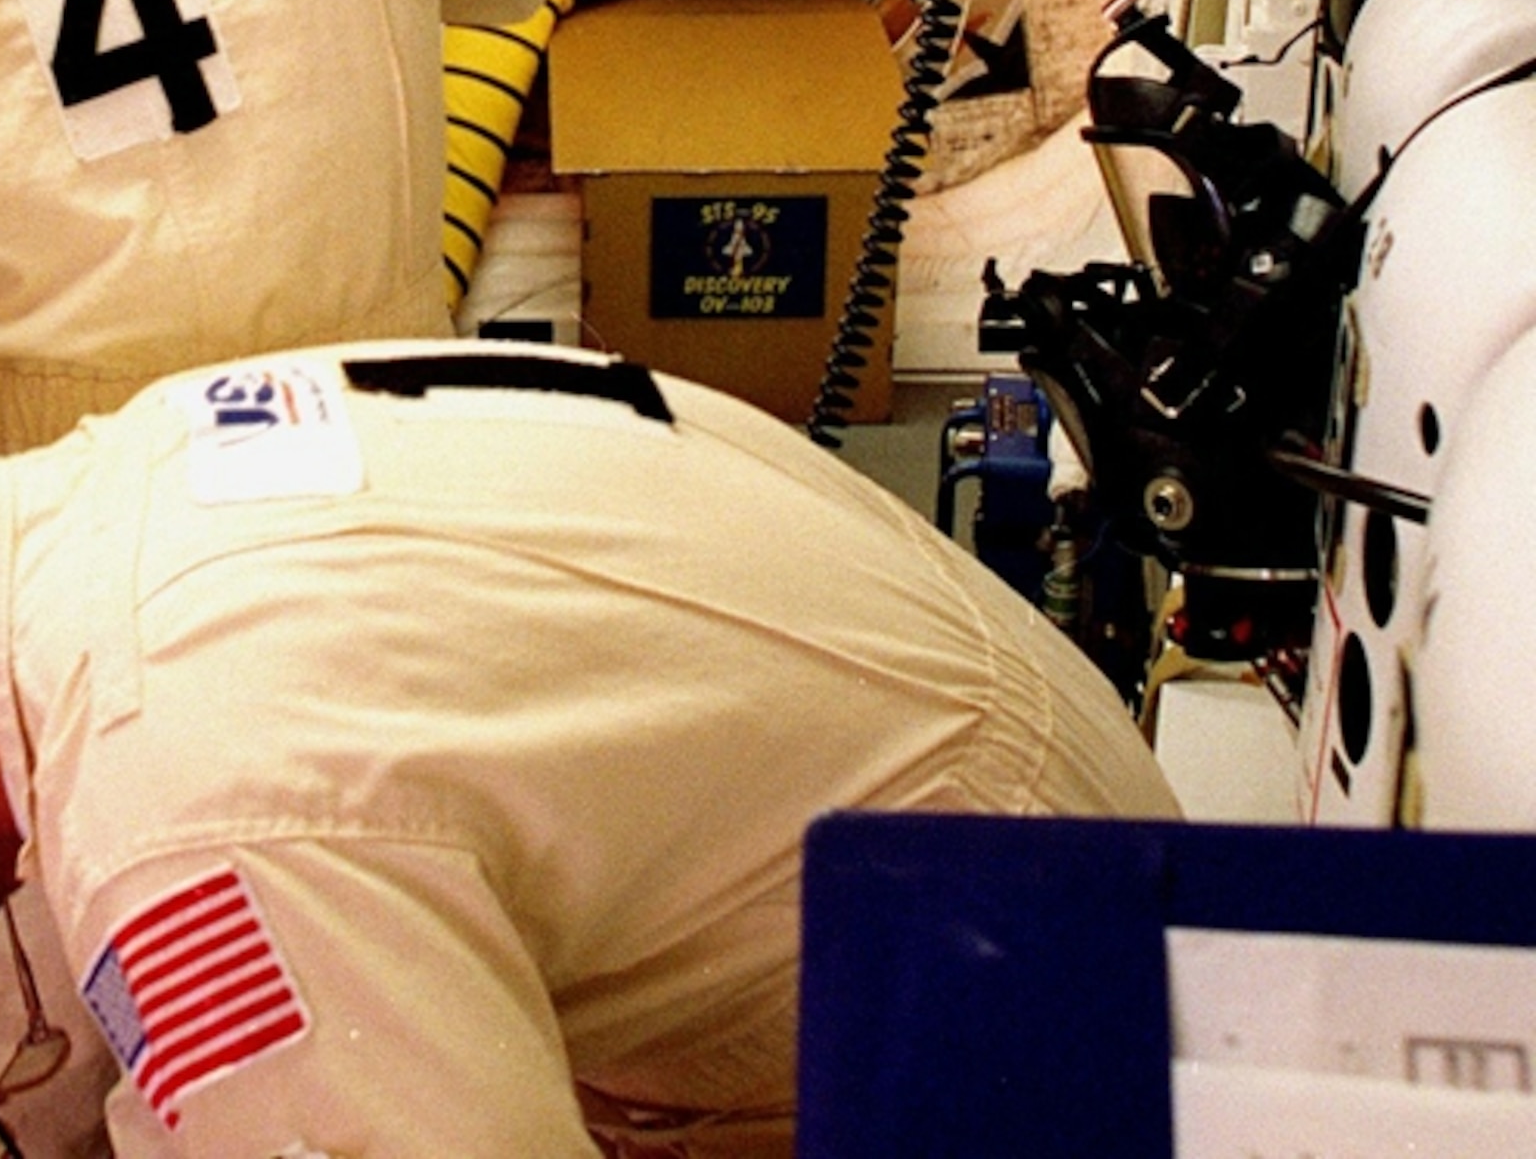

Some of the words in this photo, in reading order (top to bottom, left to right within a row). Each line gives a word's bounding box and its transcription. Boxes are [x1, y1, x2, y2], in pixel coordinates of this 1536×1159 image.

[701, 202, 780, 224] STS-95
[684, 276, 792, 293] DISCOVERY
[700, 296, 775, 313] OV-103
